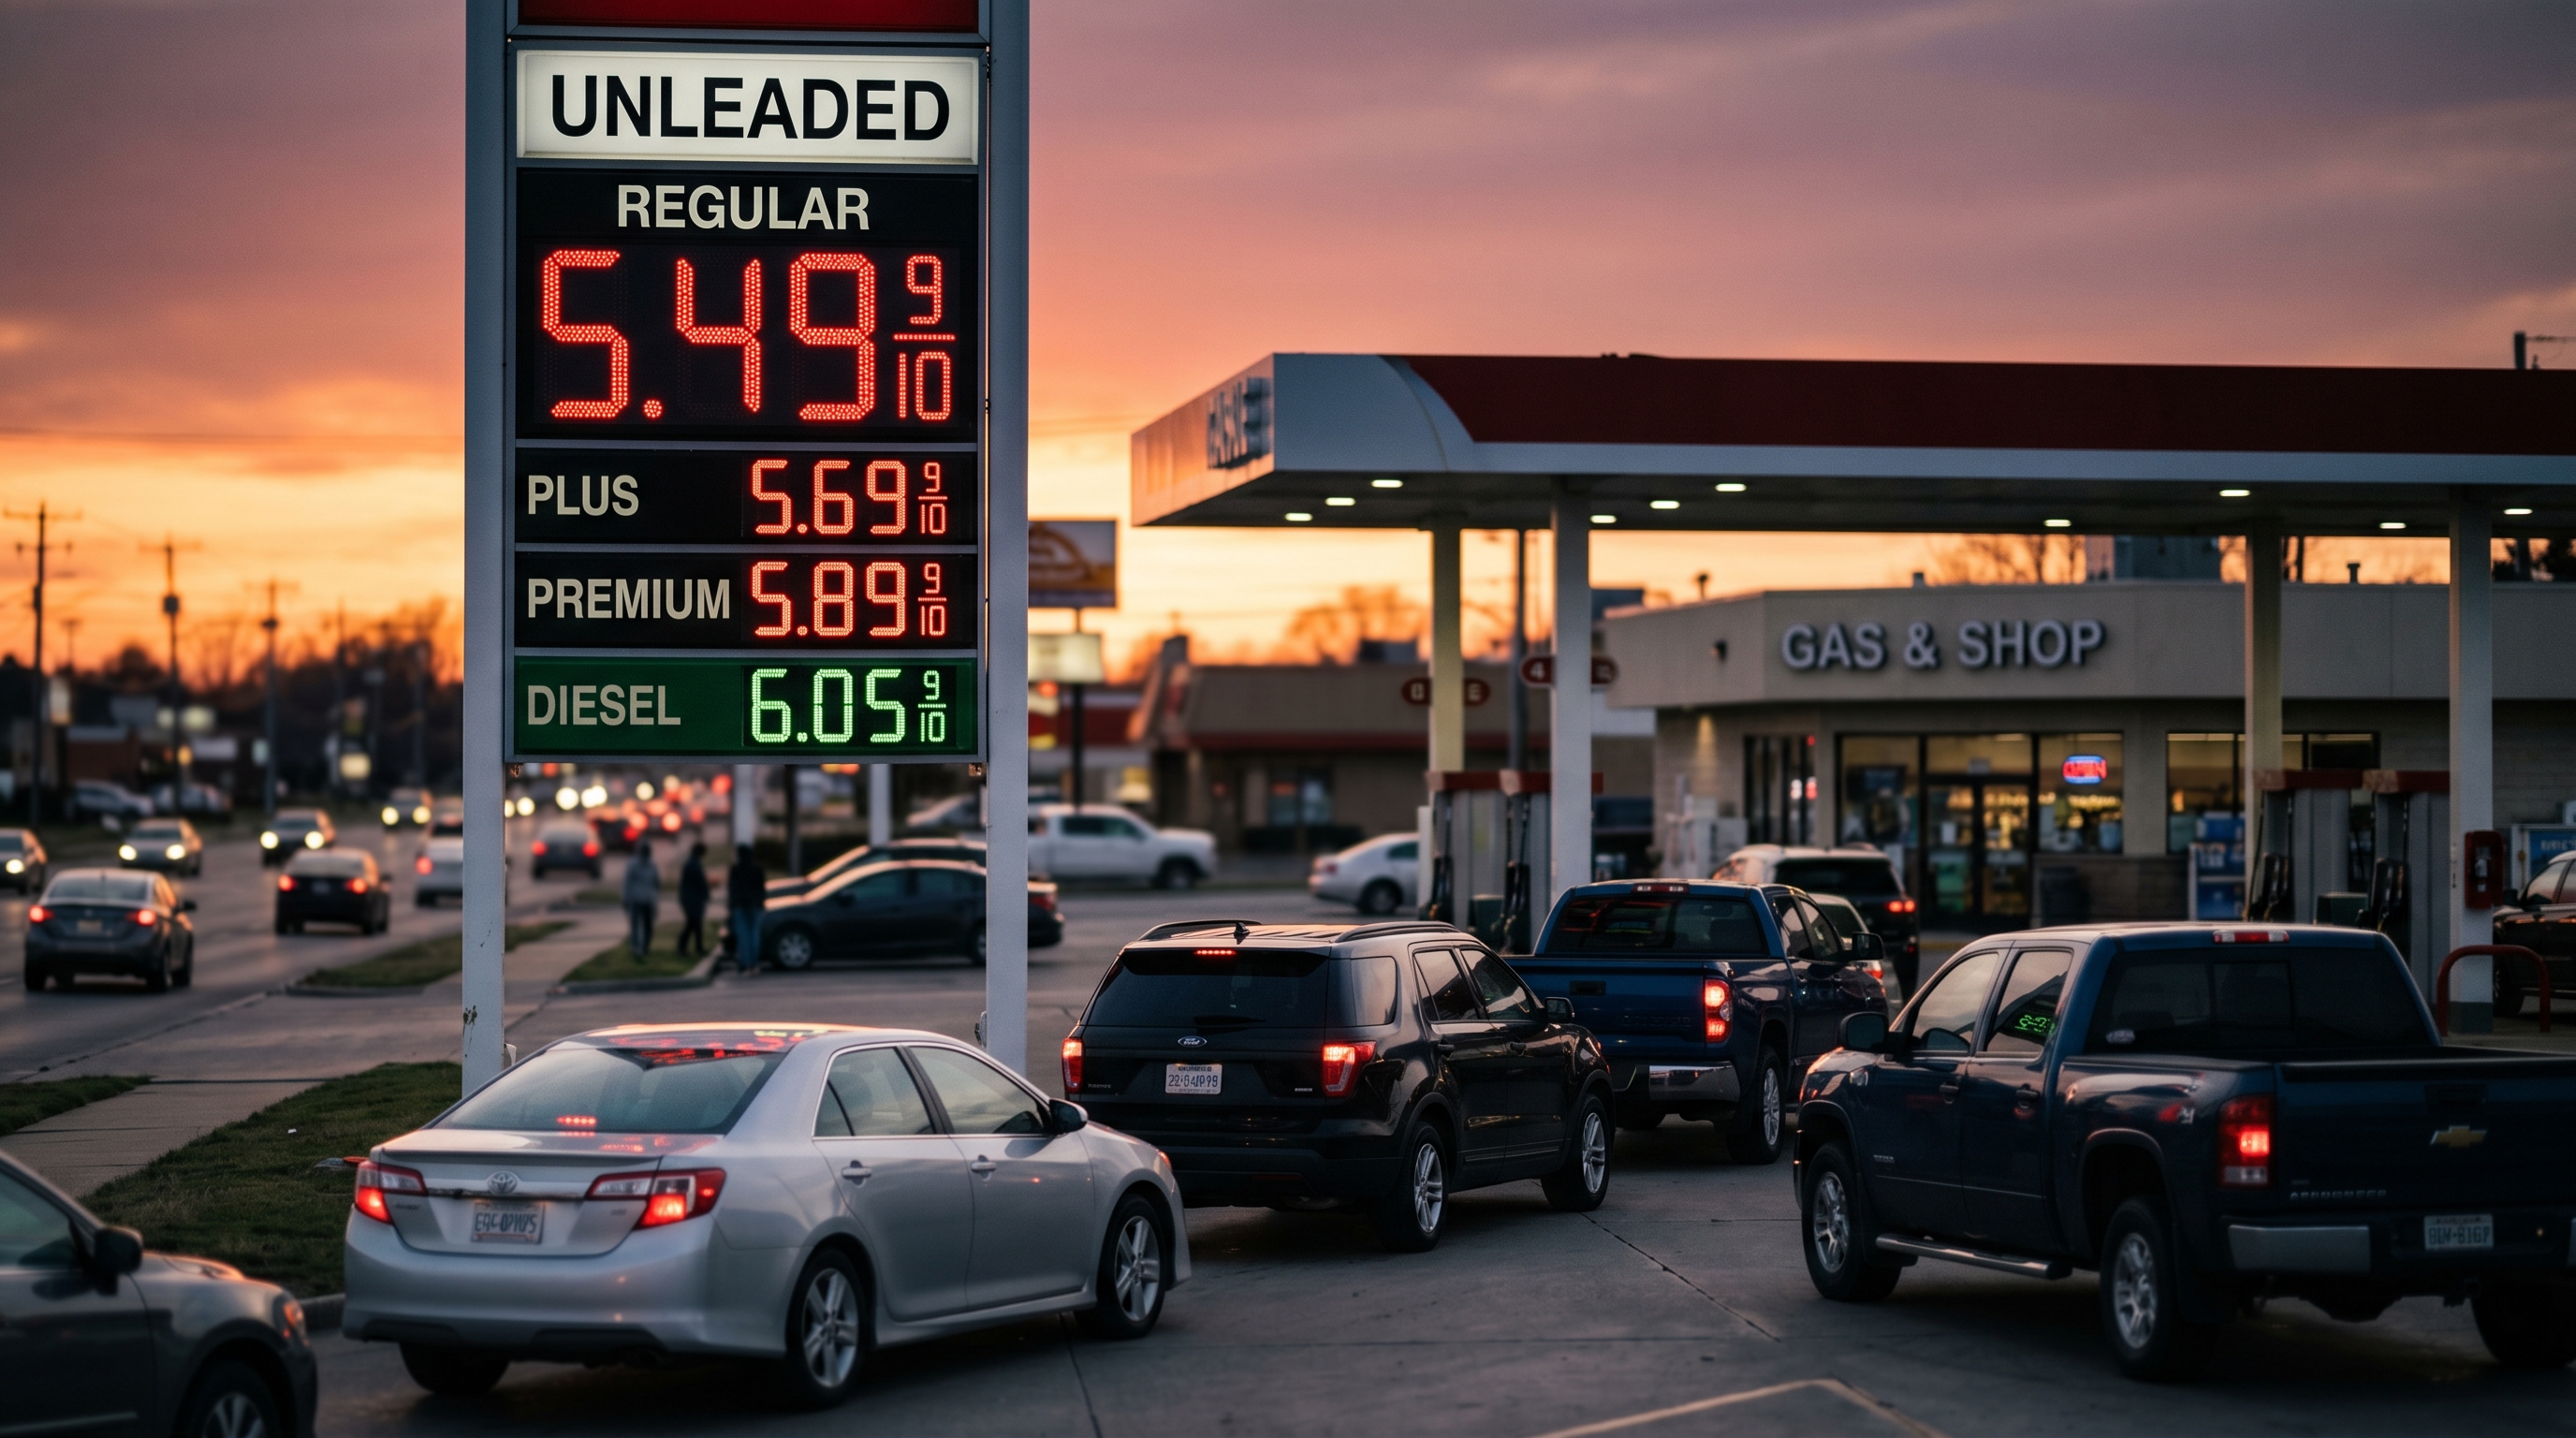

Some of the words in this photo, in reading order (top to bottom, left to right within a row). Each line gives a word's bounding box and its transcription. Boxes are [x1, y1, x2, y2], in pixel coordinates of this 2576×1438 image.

[552, 74, 950, 141] UNLEADED
[618, 184, 870, 230] REGULAR
[542, 249, 876, 421] 5.49
[528, 475, 639, 517] PLUS
[751, 459, 907, 536] 5.69
[528, 578, 730, 620] PREMIUM
[751, 561, 907, 638] 5.89
[1782, 622, 1886, 669] GAS
[1904, 622, 1939, 668] &
[1958, 619, 2105, 668] SHOP
[528, 684, 681, 726] DIESEL
[751, 668, 906, 743] 6.05
